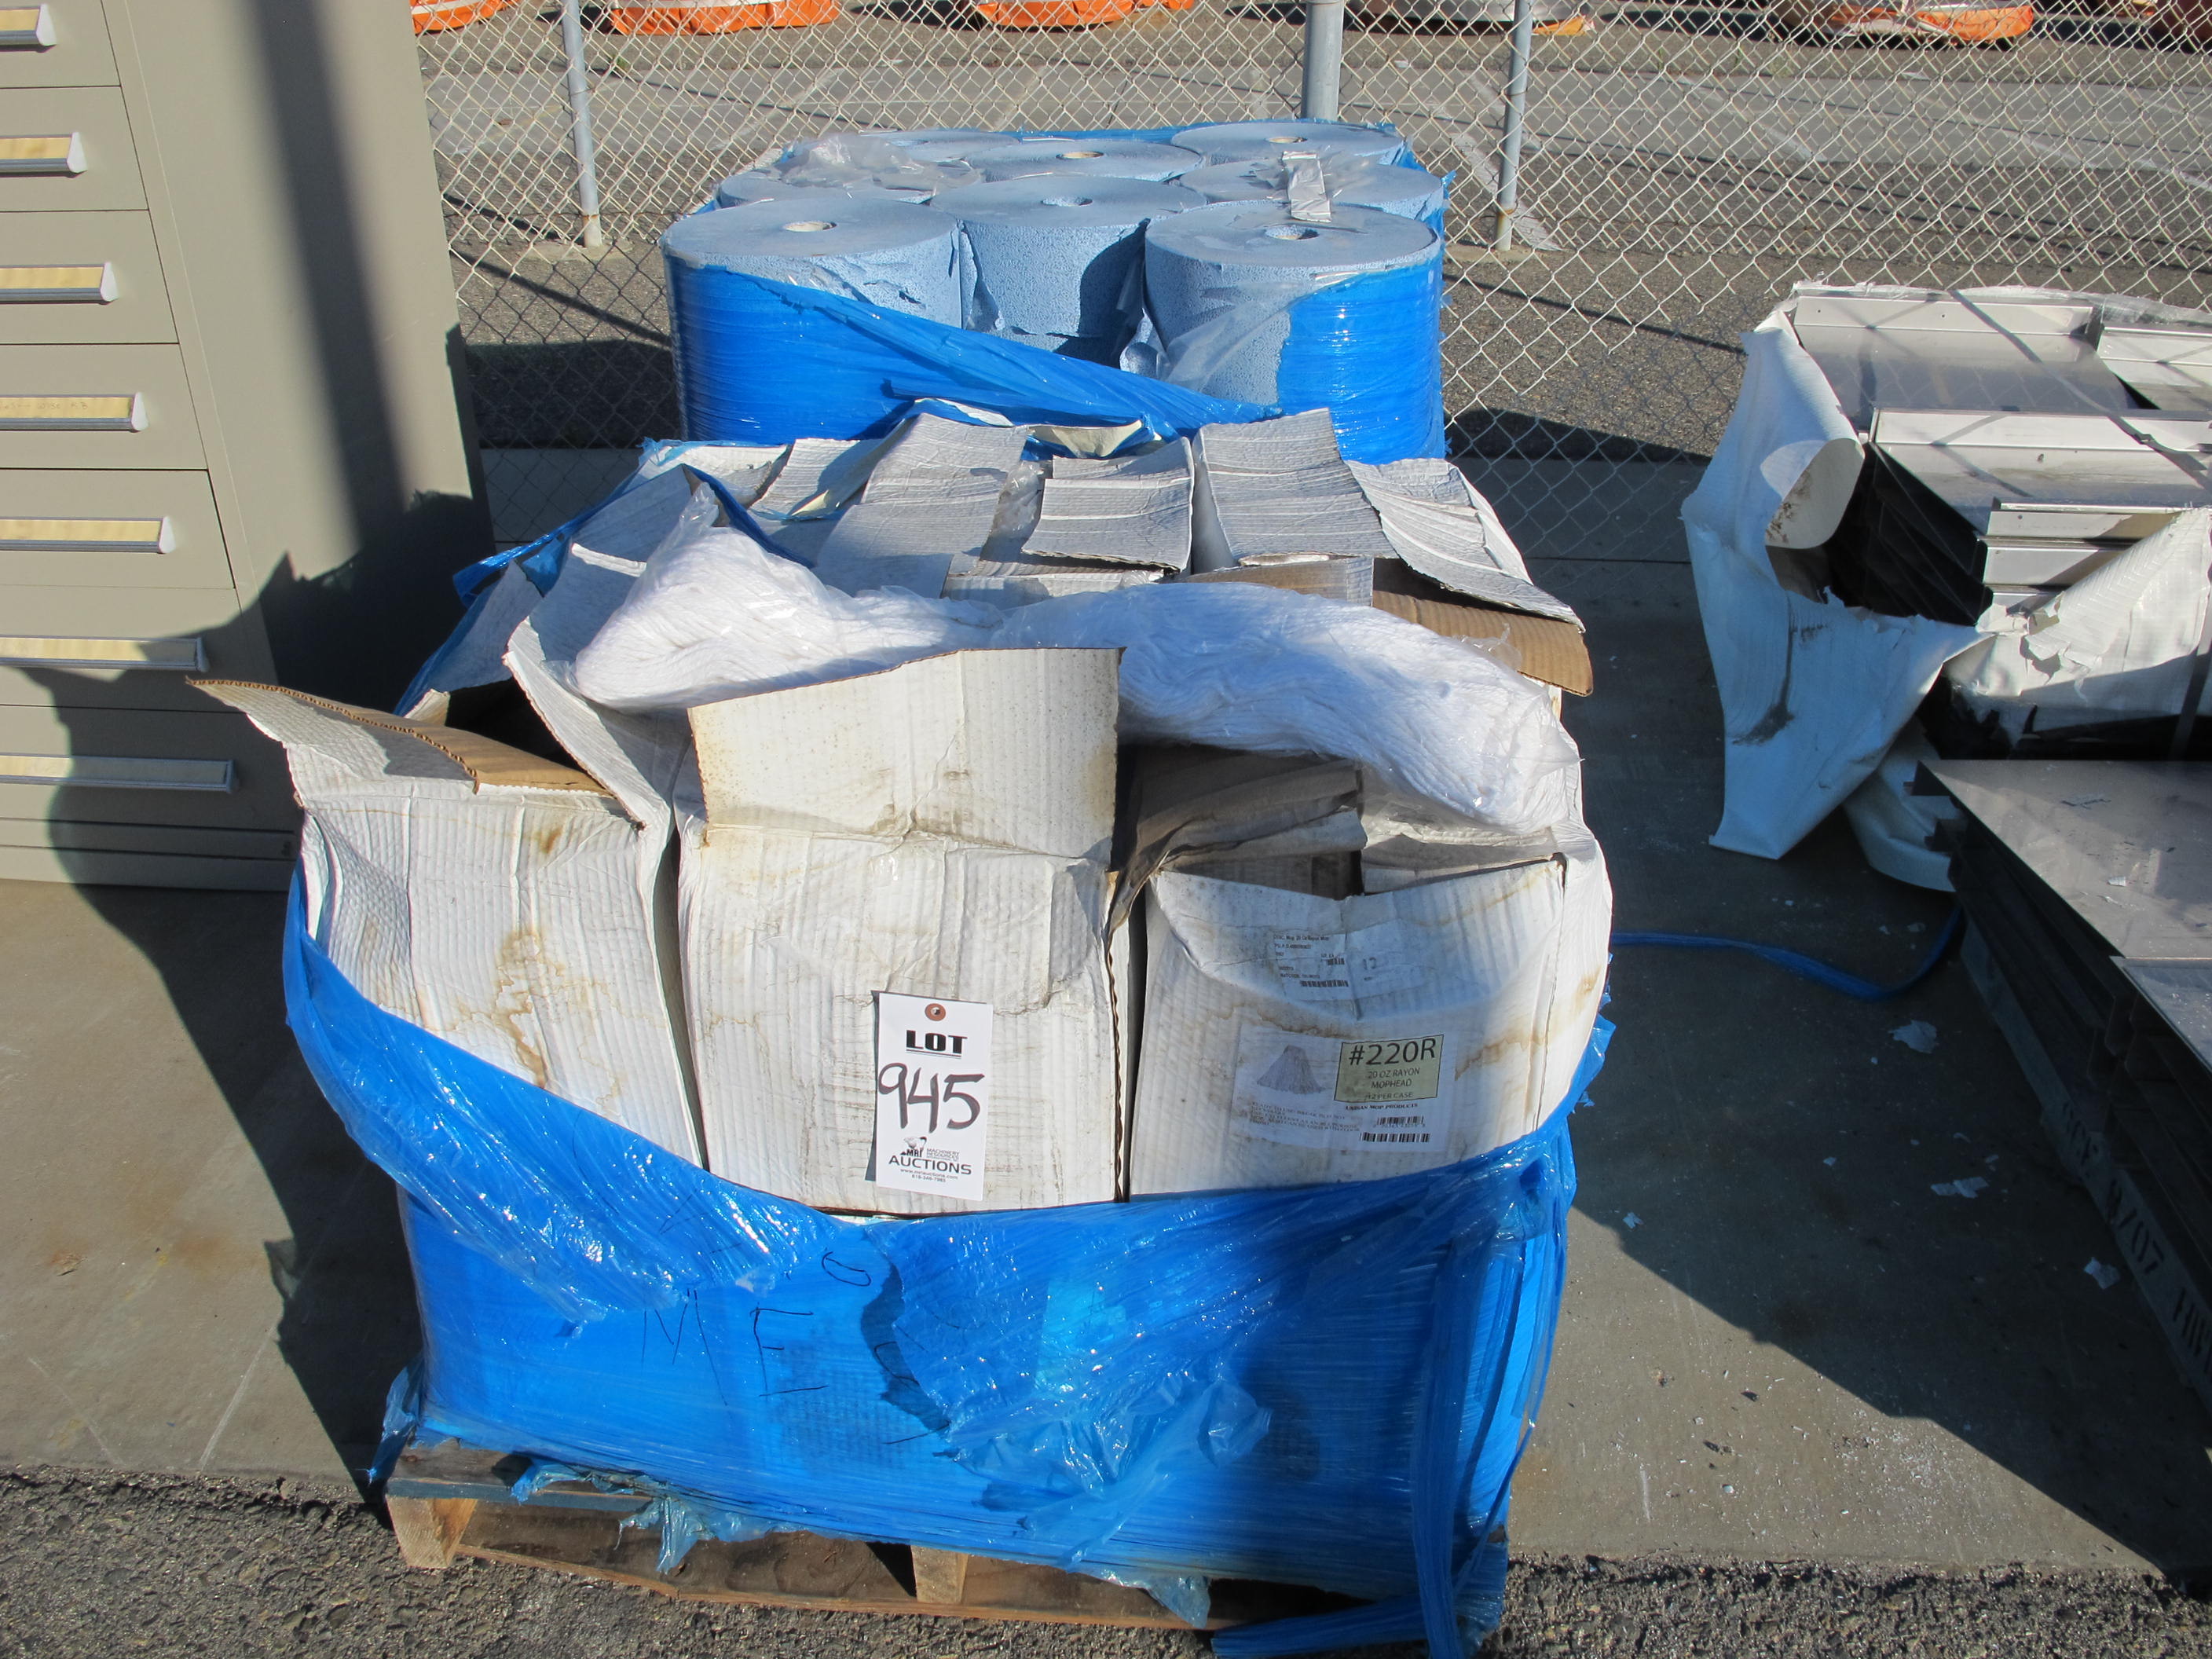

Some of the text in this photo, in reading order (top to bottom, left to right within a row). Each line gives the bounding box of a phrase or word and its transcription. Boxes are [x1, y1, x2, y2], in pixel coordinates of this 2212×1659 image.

[906, 1030, 968, 1054] LOT
[1349, 1038, 1436, 1066] #220R
[1371, 1079, 1412, 1089] MOPHEAD
[1379, 1070, 1392, 1079] OZ
[1393, 1068, 1420, 1077] RAYON
[878, 1062, 985, 1133] 945
[888, 1155, 972, 1175] AUCTIONS
